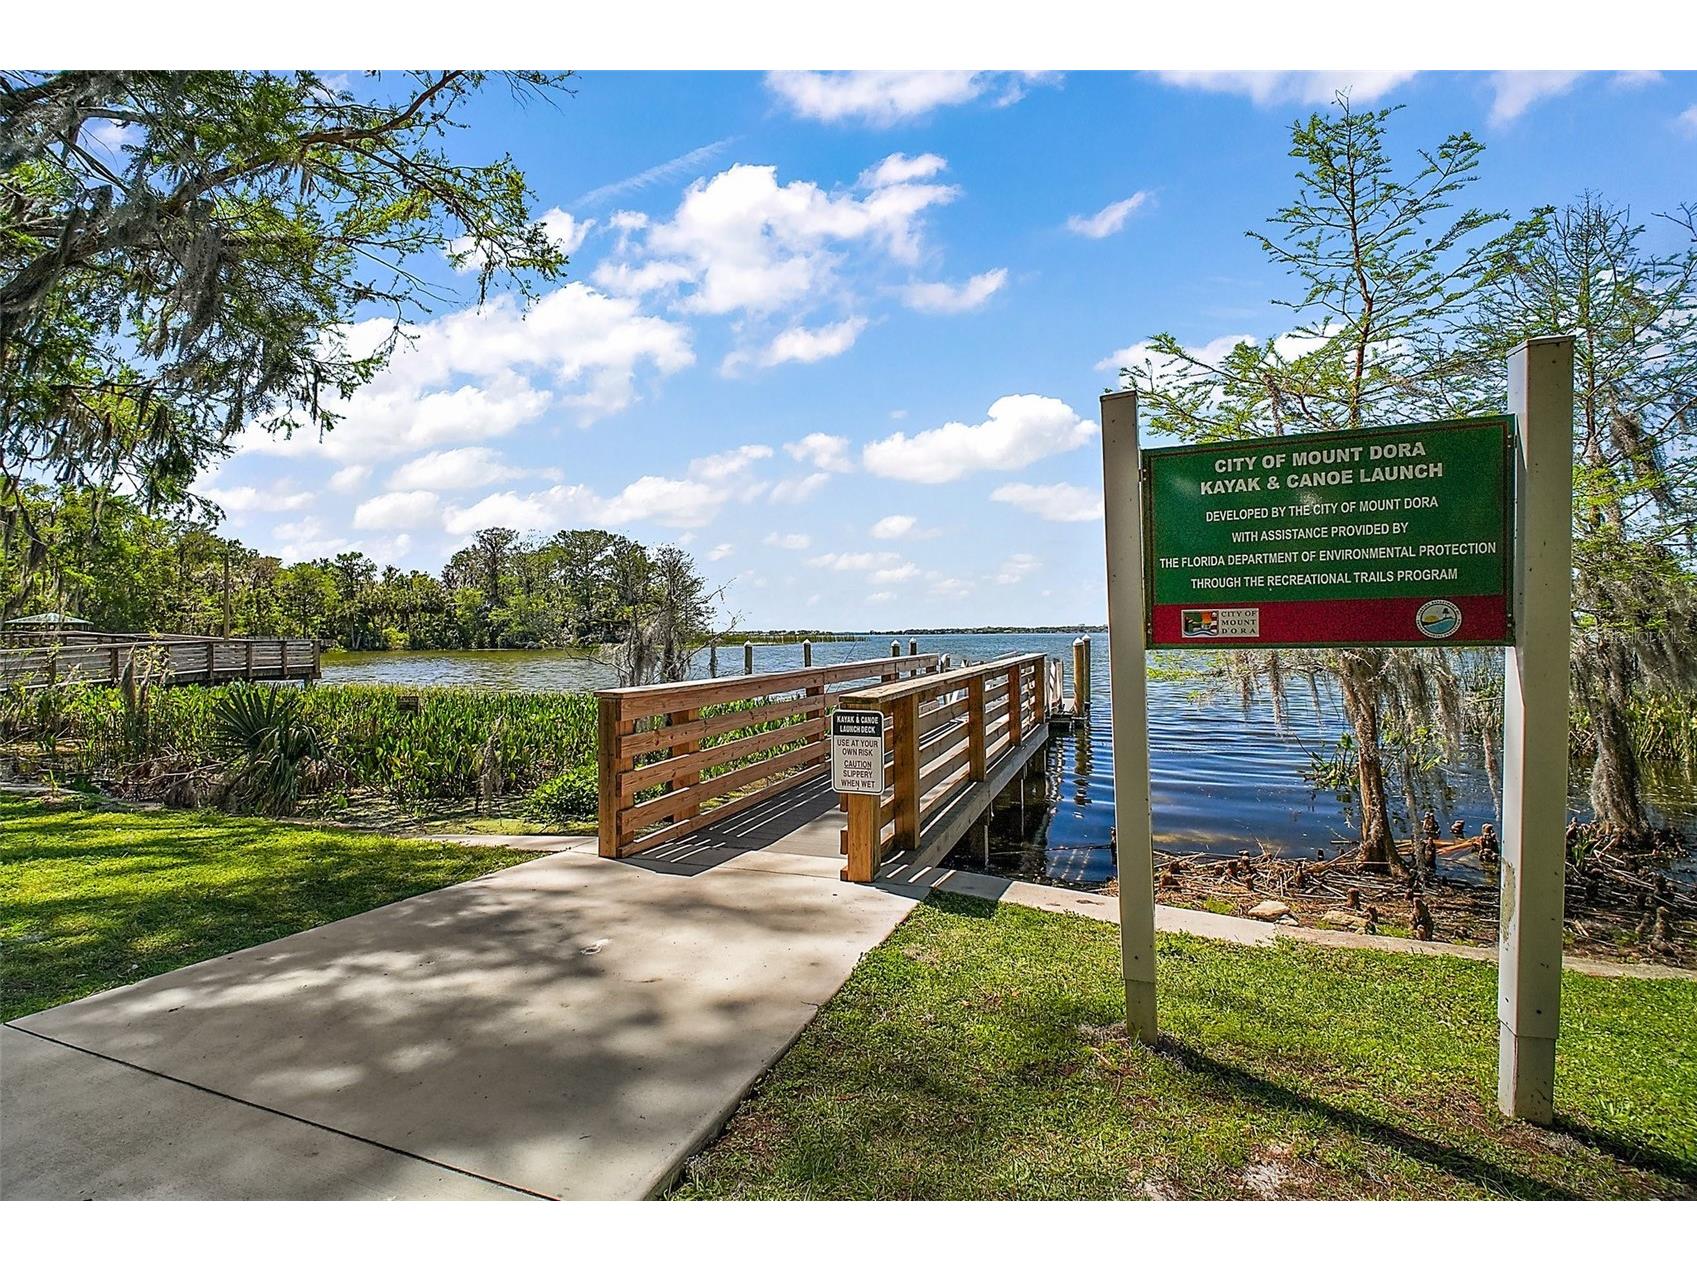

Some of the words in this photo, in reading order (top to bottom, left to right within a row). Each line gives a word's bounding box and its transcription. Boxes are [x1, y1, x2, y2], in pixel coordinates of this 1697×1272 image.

[1214, 456, 1257, 473] CITY
[1261, 454, 1286, 469] OF
[1292, 447, 1363, 467] MOUNT
[1369, 441, 1426, 460] DORA
[1200, 477, 1261, 495] KAYAK
[1266, 475, 1280, 490] &
[1286, 470, 1353, 488] CANOE
[1359, 462, 1443, 483] LAUNCH
[1206, 507, 1269, 522] DEVELOPED
[1271, 506, 1286, 518] BY
[1289, 504, 1310, 516] THE
[1313, 502, 1339, 515] CITY
[1340, 501, 1356, 513] OF
[1359, 498, 1401, 512] MOUNT
[1404, 496, 1439, 509] DORA
[1231, 530, 1258, 543] WITH
[1260, 526, 1328, 542] ASSISTANCE
[1331, 523, 1389, 537] PROVIDED
[1392, 522, 1409, 534] BY
[1160, 557, 1179, 569] THE
[1181, 554, 1225, 568] FLORIDA
[1227, 551, 1299, 566] DEPARTMENT
[1301, 550, 1316, 562] OF
[1319, 546, 1416, 561] ENVIRONMENTAL
[1419, 542, 1496, 557] PROTECTION
[1191, 577, 1241, 589] THROUGH
[1243, 575, 1264, 587] THE
[1267, 572, 1351, 586] RECREATIONAL
[1354, 570, 1394, 583] TRAILS
[1397, 568, 1458, 581] PROGRAM
[860, 716, 878, 724] CANOE
[843, 770, 872, 778] SLIPPERY
[844, 760, 872, 769] CAUTION
[841, 780, 860, 788] WHEN
